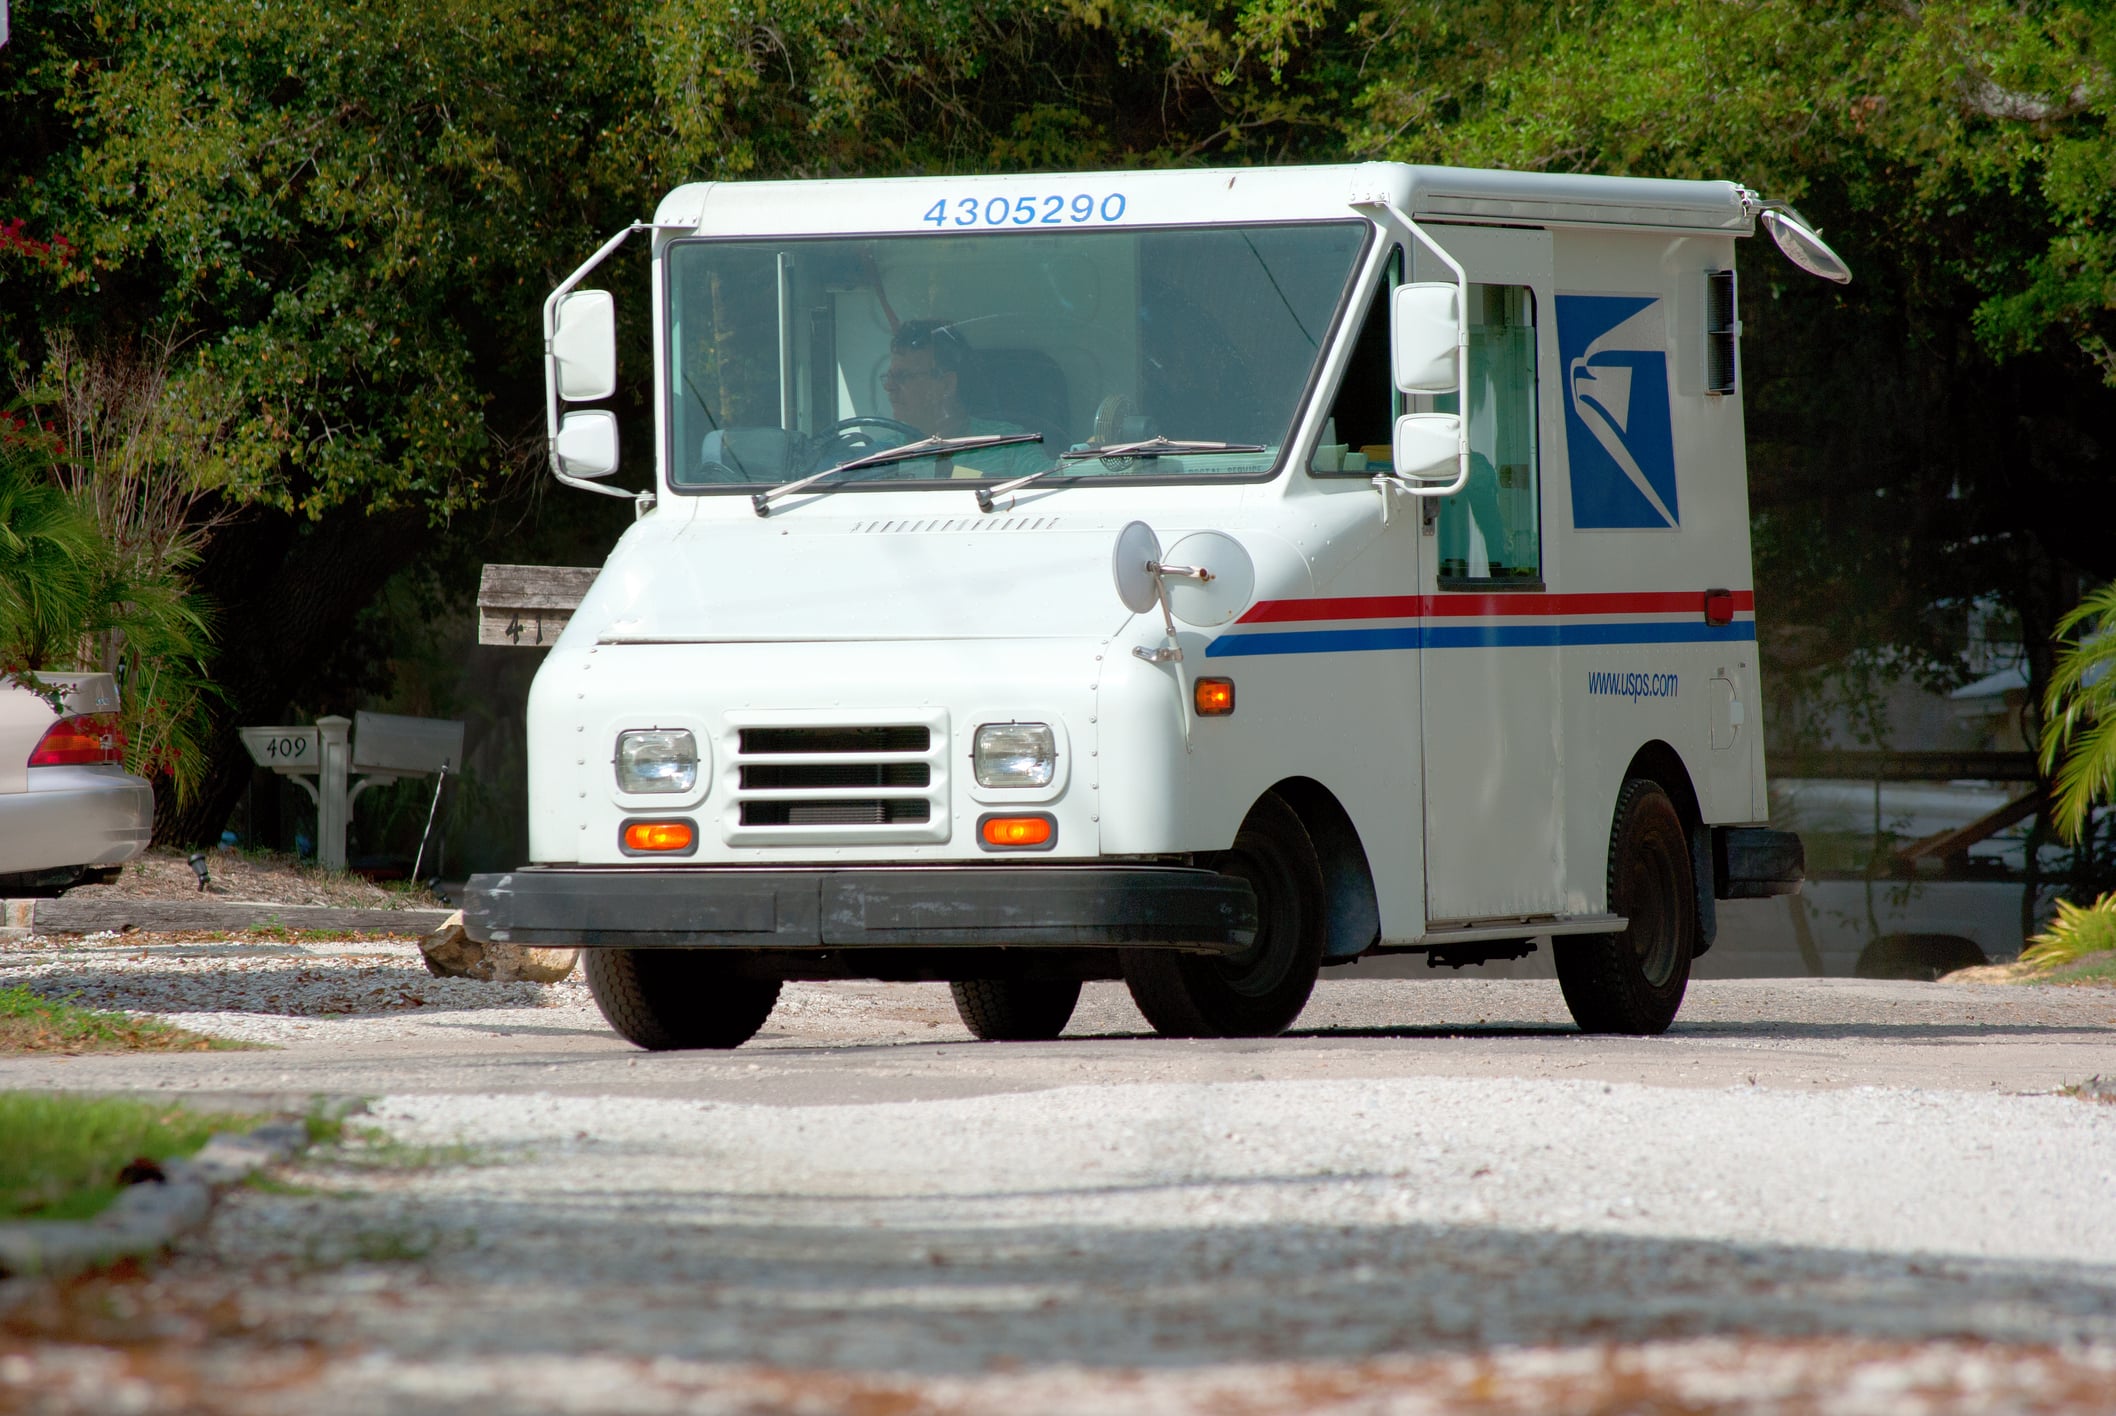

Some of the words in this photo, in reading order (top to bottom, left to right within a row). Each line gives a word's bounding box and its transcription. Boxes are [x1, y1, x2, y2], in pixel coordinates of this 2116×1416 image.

[923, 193, 1126, 227] 4305290
[505, 613, 570, 645] 41
[1588, 671, 1679, 704] www.usps.com
[266, 737, 306, 759] 409
